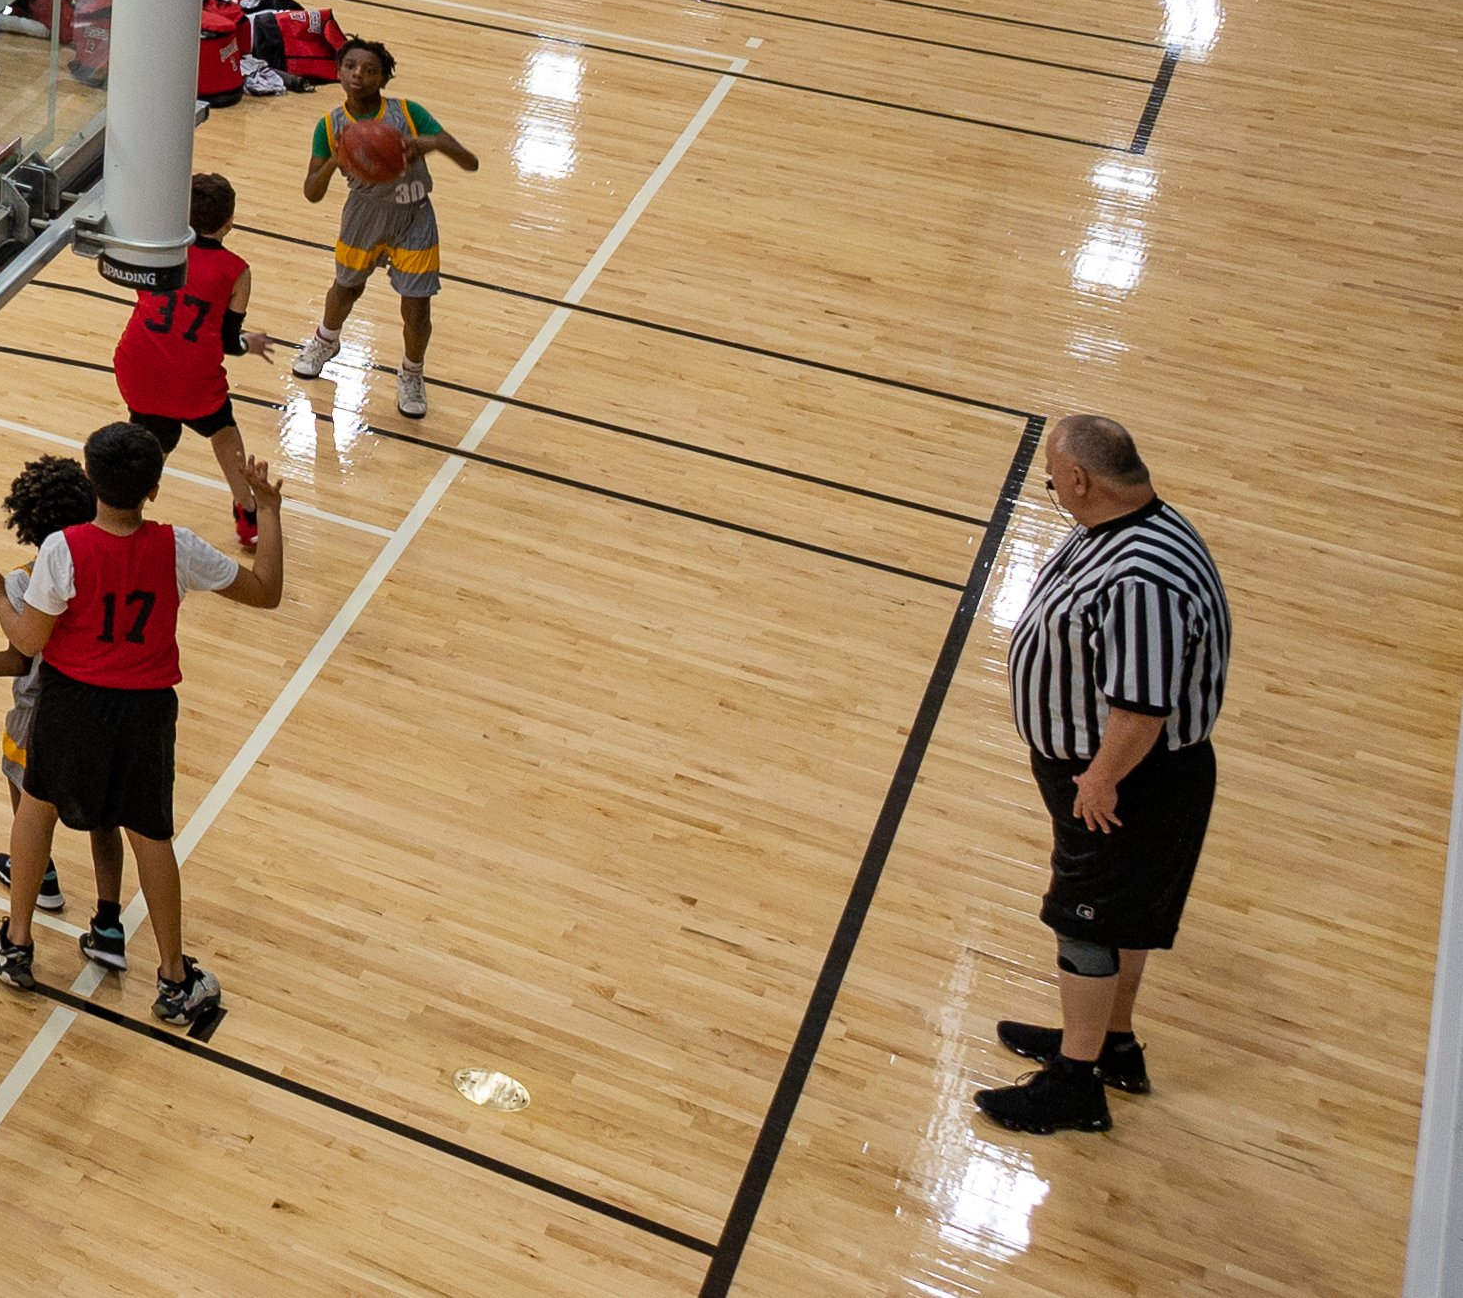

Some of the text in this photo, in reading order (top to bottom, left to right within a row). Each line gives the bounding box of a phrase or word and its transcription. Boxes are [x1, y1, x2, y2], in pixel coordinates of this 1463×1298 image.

[395, 180, 425, 204] 30
[102, 261, 157, 286] SPALDING
[144, 288, 211, 343] 37
[96, 589, 156, 645] 17
